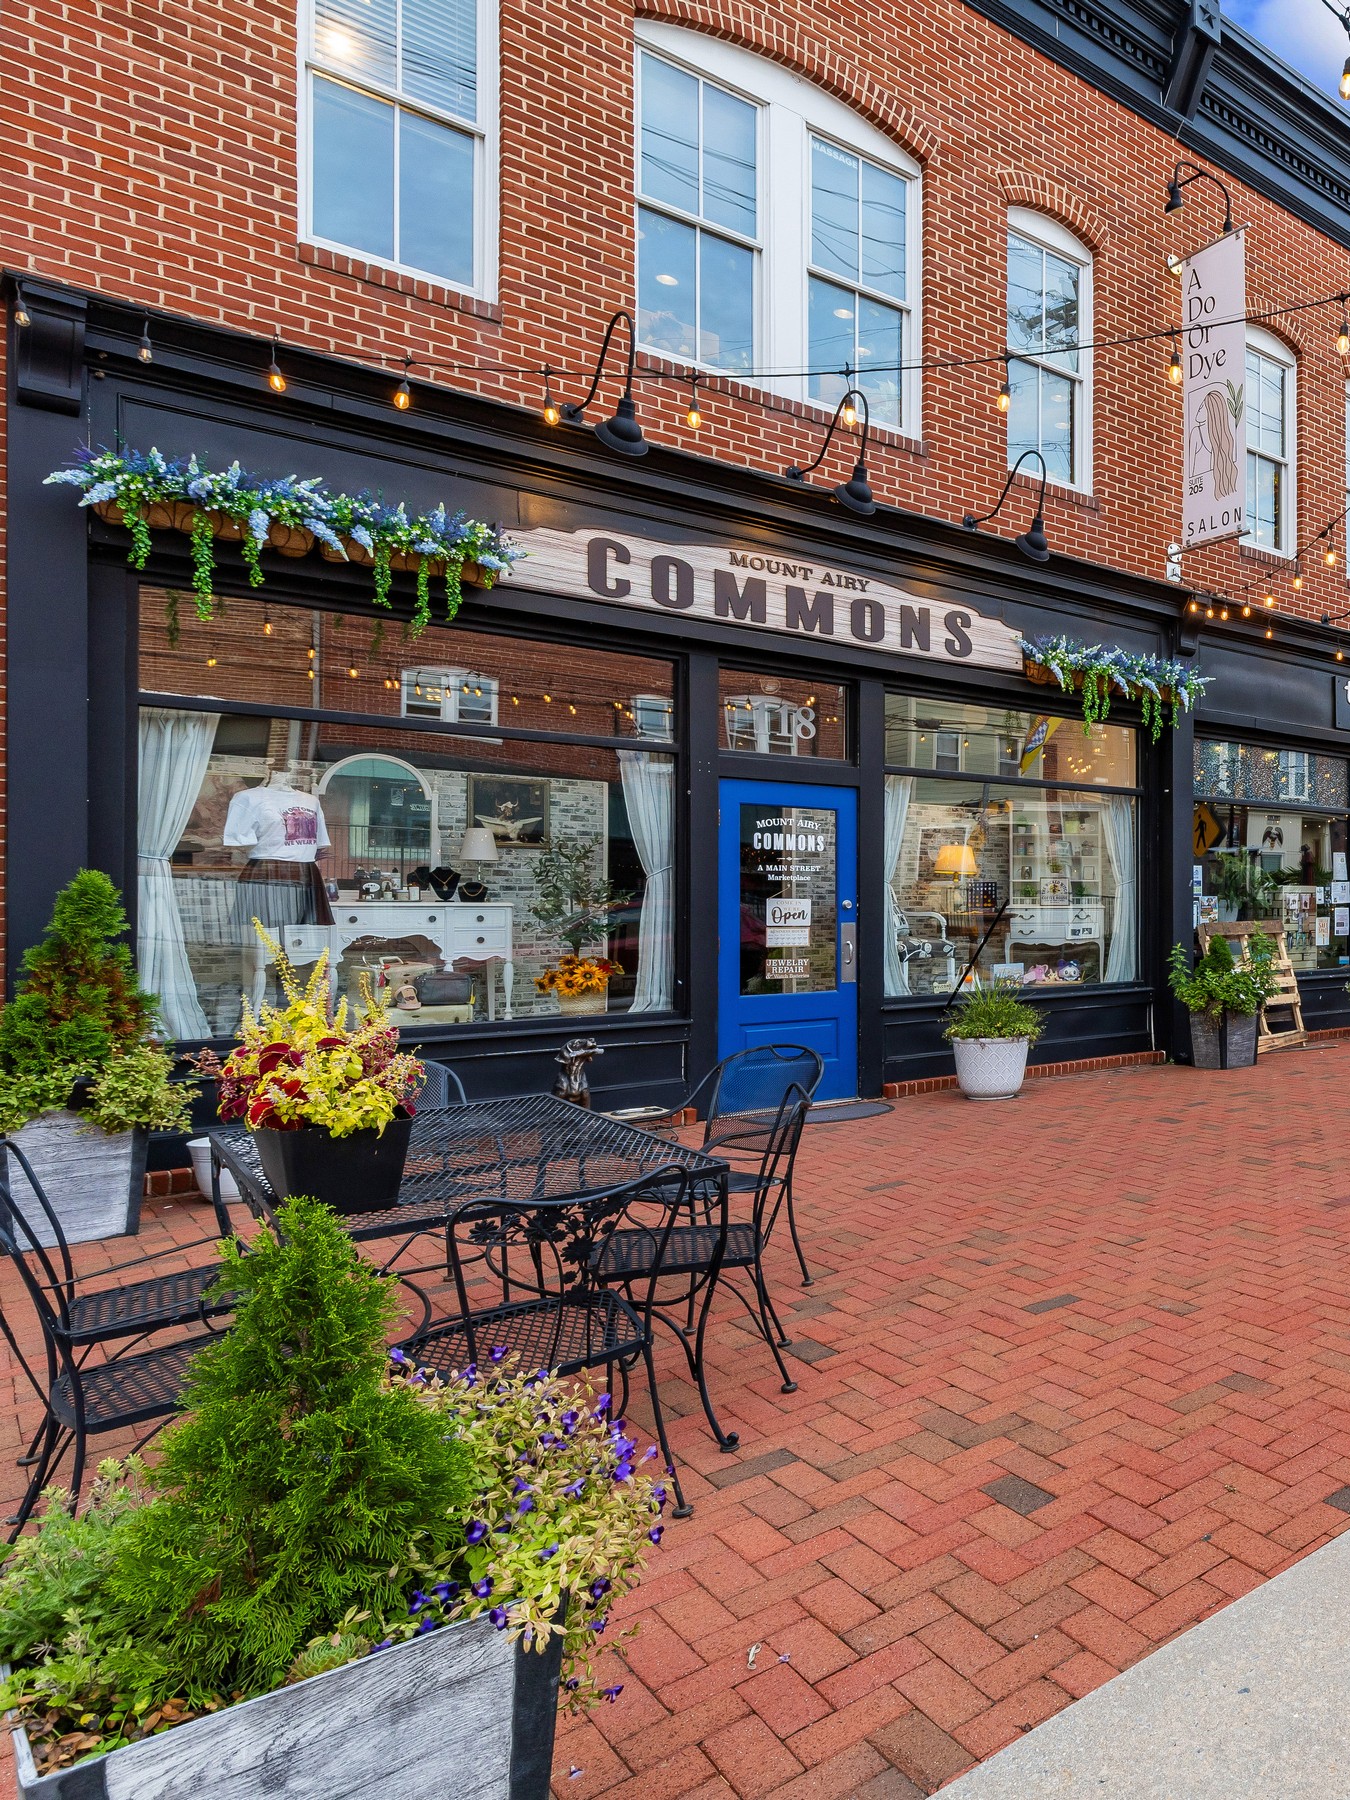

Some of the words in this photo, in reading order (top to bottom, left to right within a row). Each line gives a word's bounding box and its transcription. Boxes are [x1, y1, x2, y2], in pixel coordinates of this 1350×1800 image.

[811, 141, 858, 170] MASSAGE
[1008, 236, 1039, 256] WAXING
[1187, 268, 1202, 295] A
[1188, 296, 1216, 323] Do
[1188, 324, 1213, 349] Or
[1189, 349, 1227, 380] Dye
[1188, 476, 1204, 487] SUITE
[1188, 484, 1204, 496] 205
[1187, 506, 1242, 537] SALON
[729, 551, 814, 581] MOUNT
[819, 571, 871, 592] AIRY
[587, 537, 973, 658] COMMONS
[753, 701, 817, 740] 118
[756, 818, 795, 829] MOUNT
[797, 820, 822, 831] AIRY
[753, 832, 825, 852] COMMONS
[765, 864, 788, 872] MAIN
[767, 874, 811, 882] Marketplace
[771, 906, 809, 924] Open
[766, 958, 809, 967] JEWELRY
[771, 966, 804, 974] REPAIR
